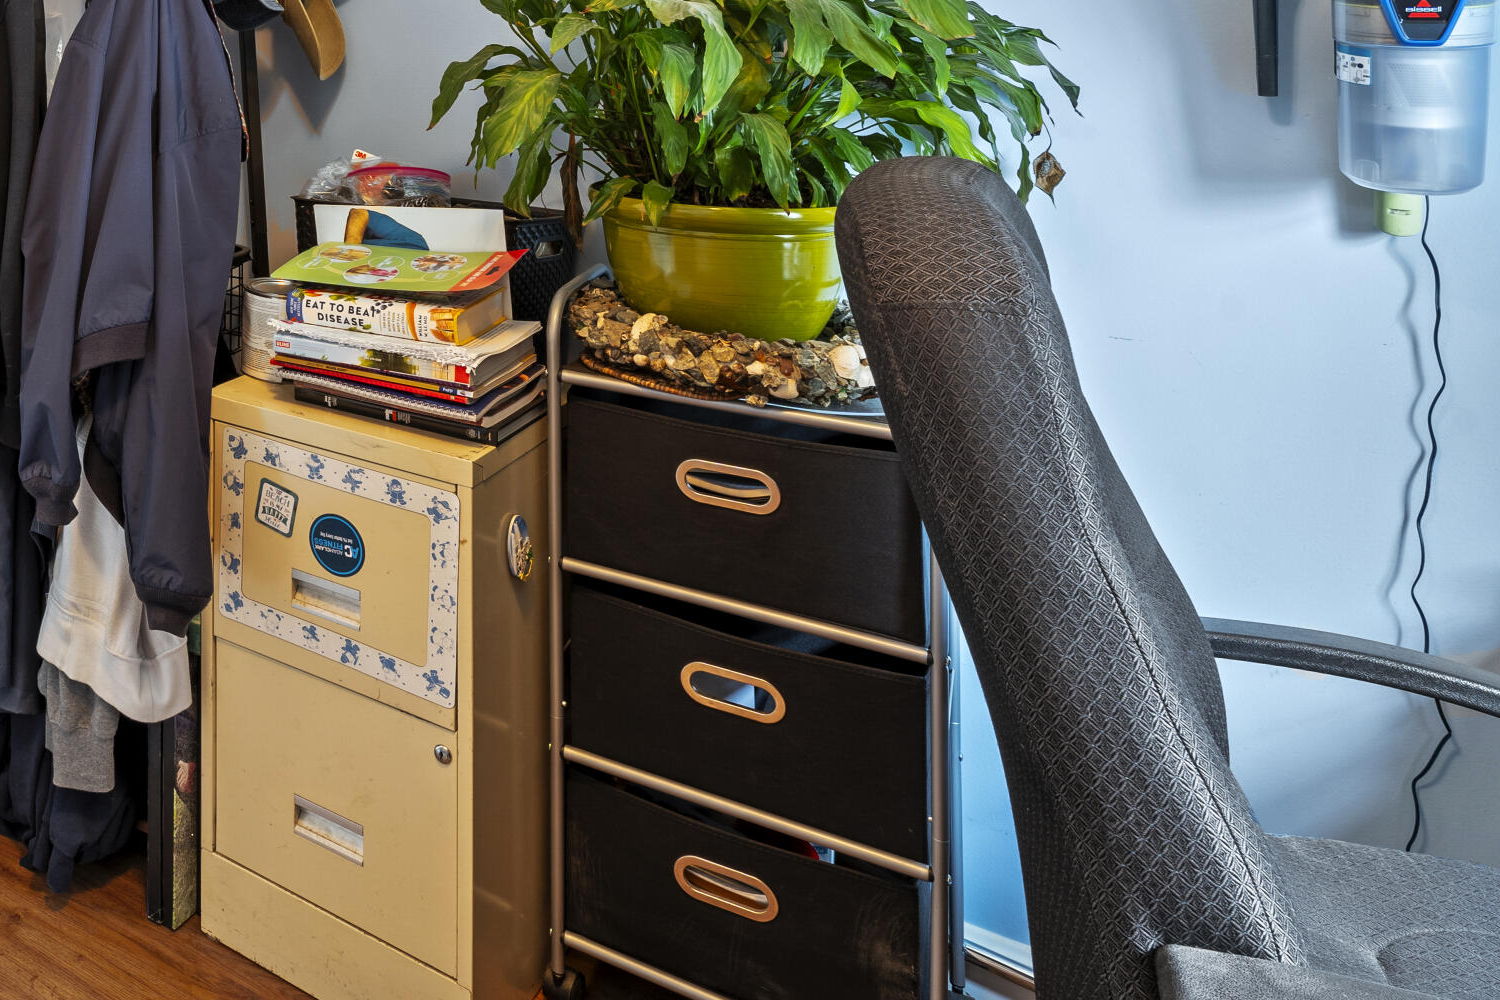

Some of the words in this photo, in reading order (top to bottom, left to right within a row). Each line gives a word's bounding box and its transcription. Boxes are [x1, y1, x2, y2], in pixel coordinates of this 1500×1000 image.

[354, 150, 366, 159] 3M
[306, 300, 326, 310] EAT
[330, 302, 344, 312] TO
[348, 306, 376, 317] BEAT
[318, 313, 364, 326] DISEASE
[314, 538, 343, 550] FITNESS
